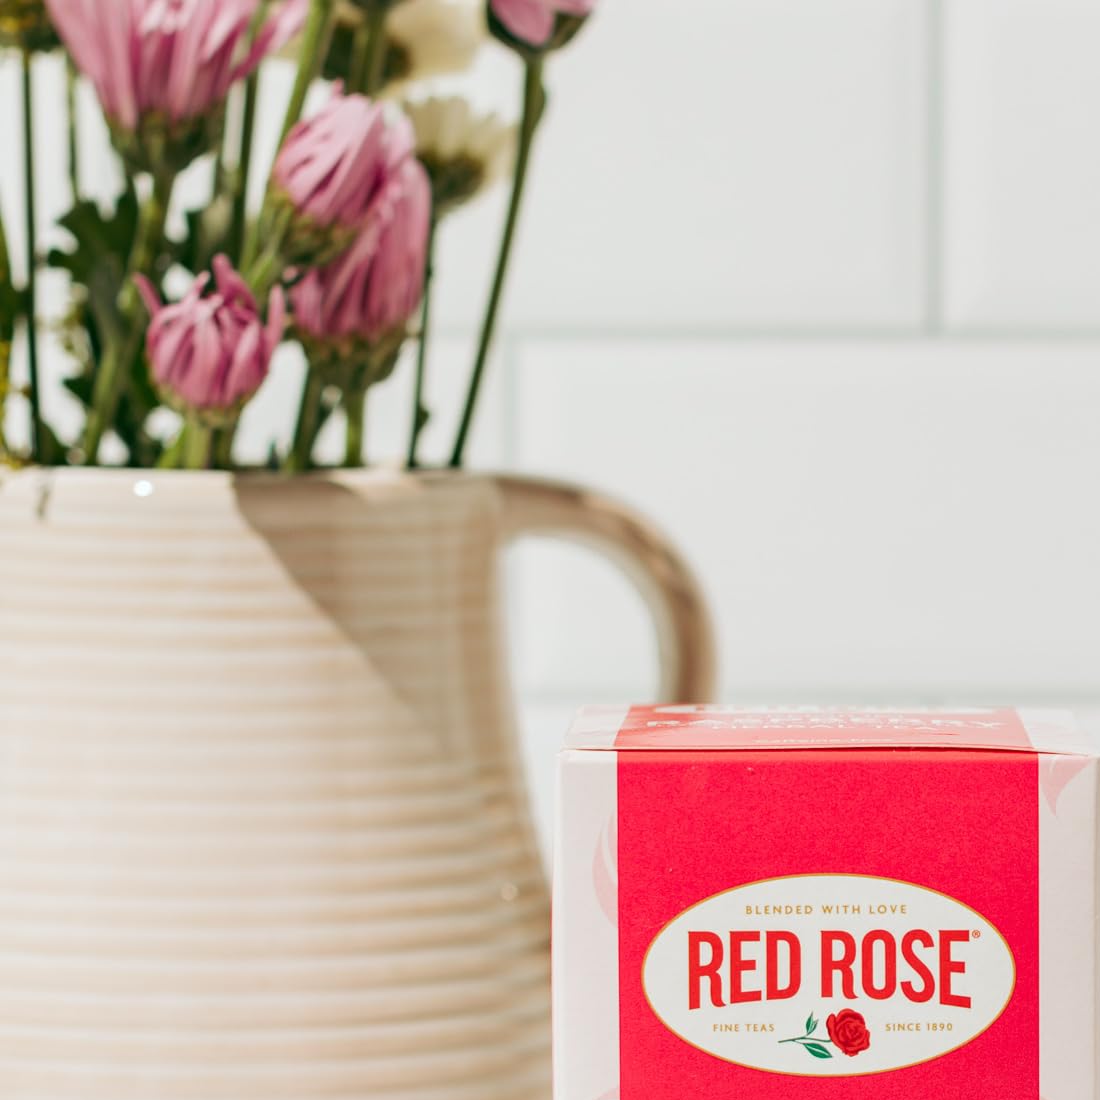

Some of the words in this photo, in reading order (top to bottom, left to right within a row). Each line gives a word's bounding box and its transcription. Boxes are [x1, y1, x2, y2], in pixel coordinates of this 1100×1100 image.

[746, 905, 813, 915] BLENDED
[822, 904, 861, 914] WITH
[869, 904, 907, 914] LOVE
[688, 930, 801, 1010] RED
[713, 1023, 740, 1032] FINE
[746, 1023, 775, 1032] TEAS
[886, 1023, 921, 1032] SINCE
[927, 1022, 953, 1032] 1890
